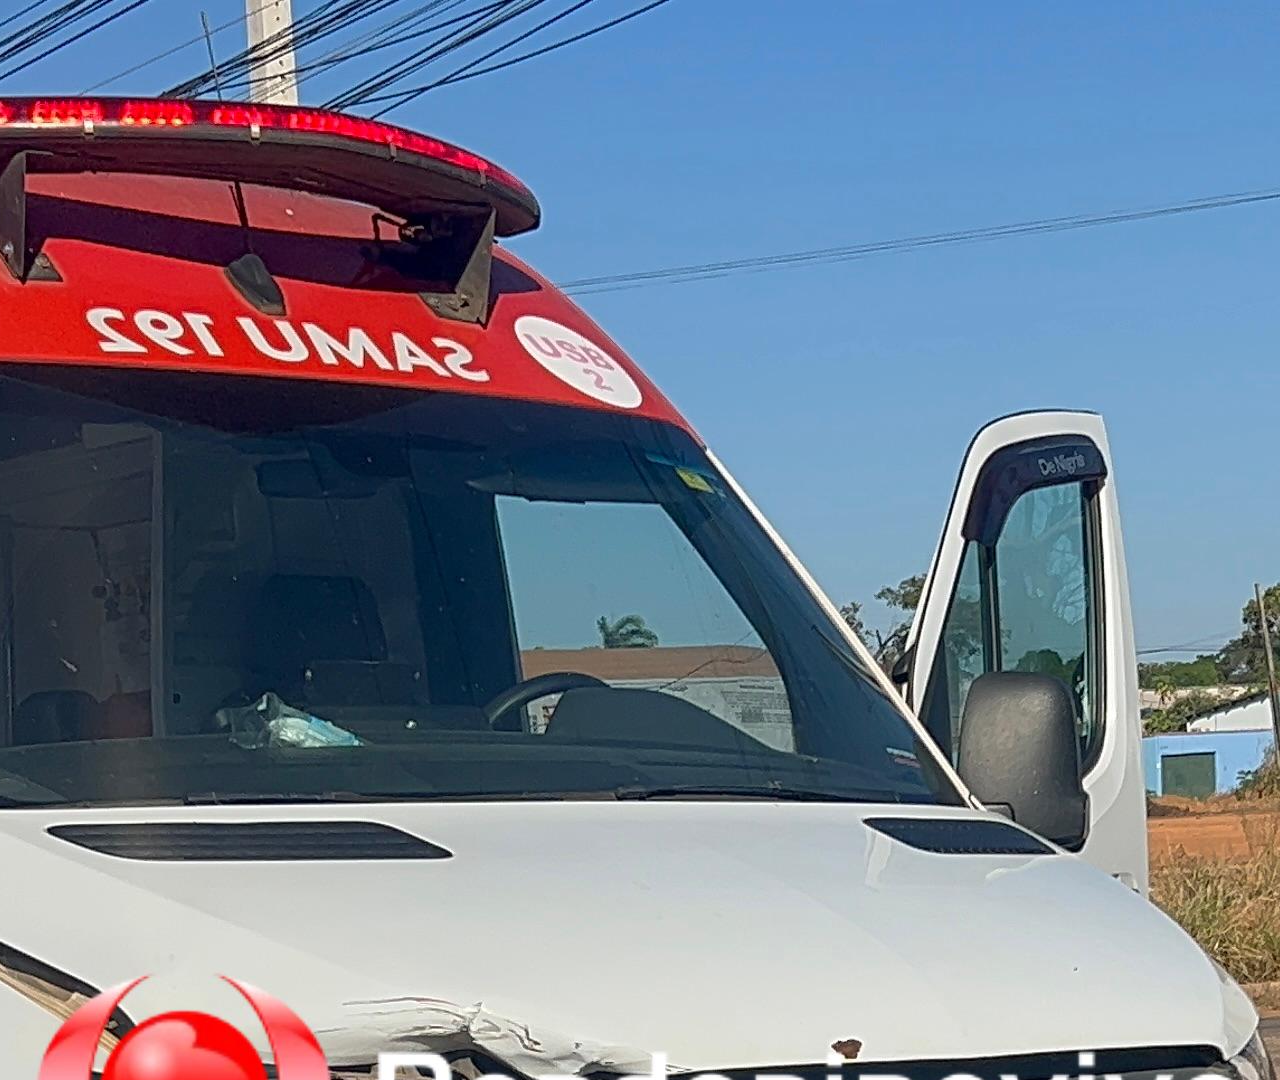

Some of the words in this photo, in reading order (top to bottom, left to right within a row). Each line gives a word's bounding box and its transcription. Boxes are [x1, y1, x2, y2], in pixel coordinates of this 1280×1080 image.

[523, 333, 615, 371] USB
[582, 367, 614, 392] 2
[1038, 458, 1056, 476] De
